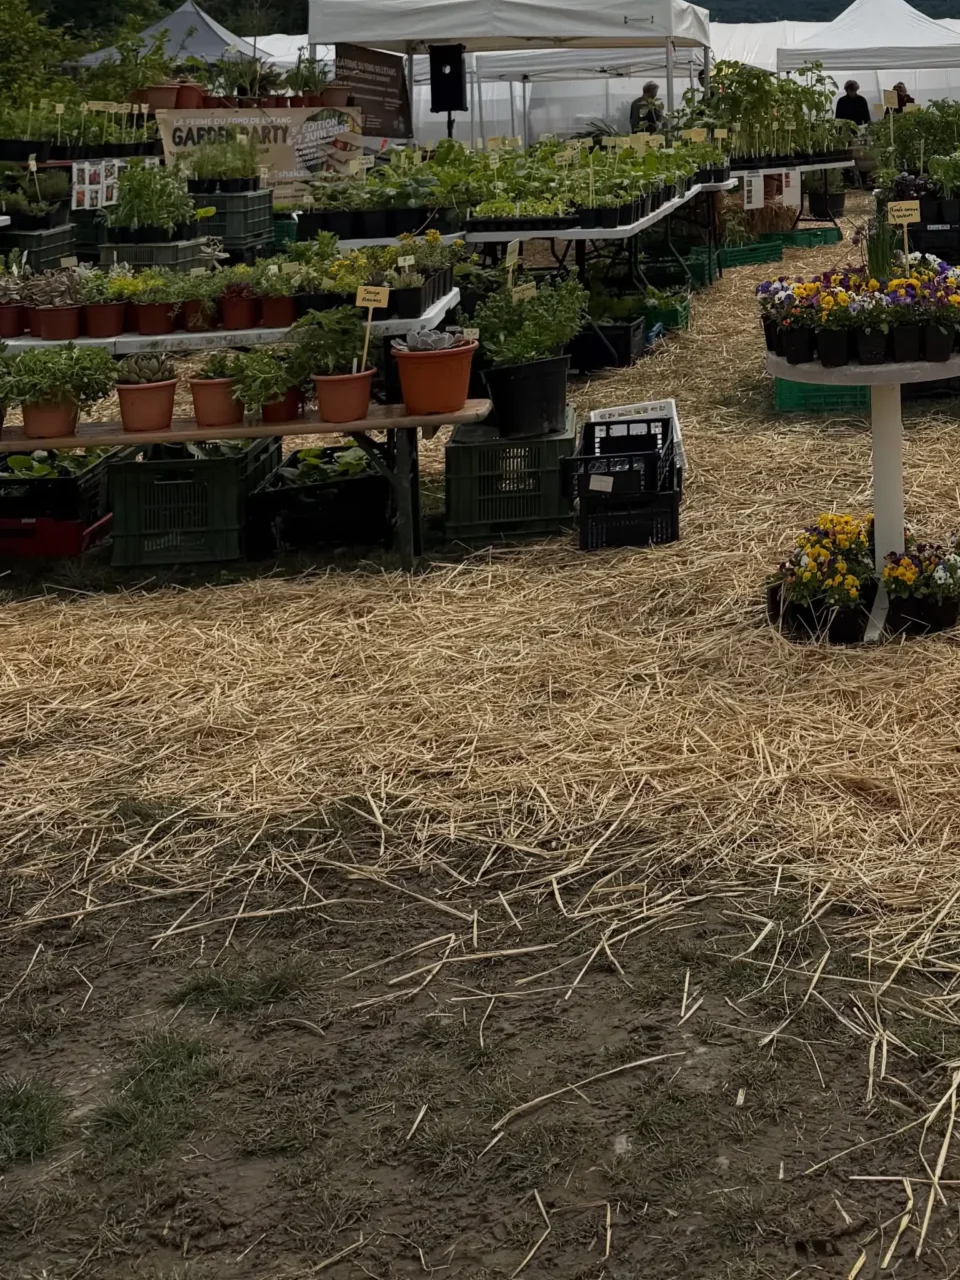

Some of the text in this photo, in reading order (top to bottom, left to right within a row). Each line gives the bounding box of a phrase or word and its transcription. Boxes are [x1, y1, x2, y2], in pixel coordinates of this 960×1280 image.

[173, 118, 184, 126] LA
[214, 117, 226, 125] DU
[228, 117, 249, 125] FOND
[304, 129, 327, 142] JUIN
[328, 123, 350, 135] 2026
